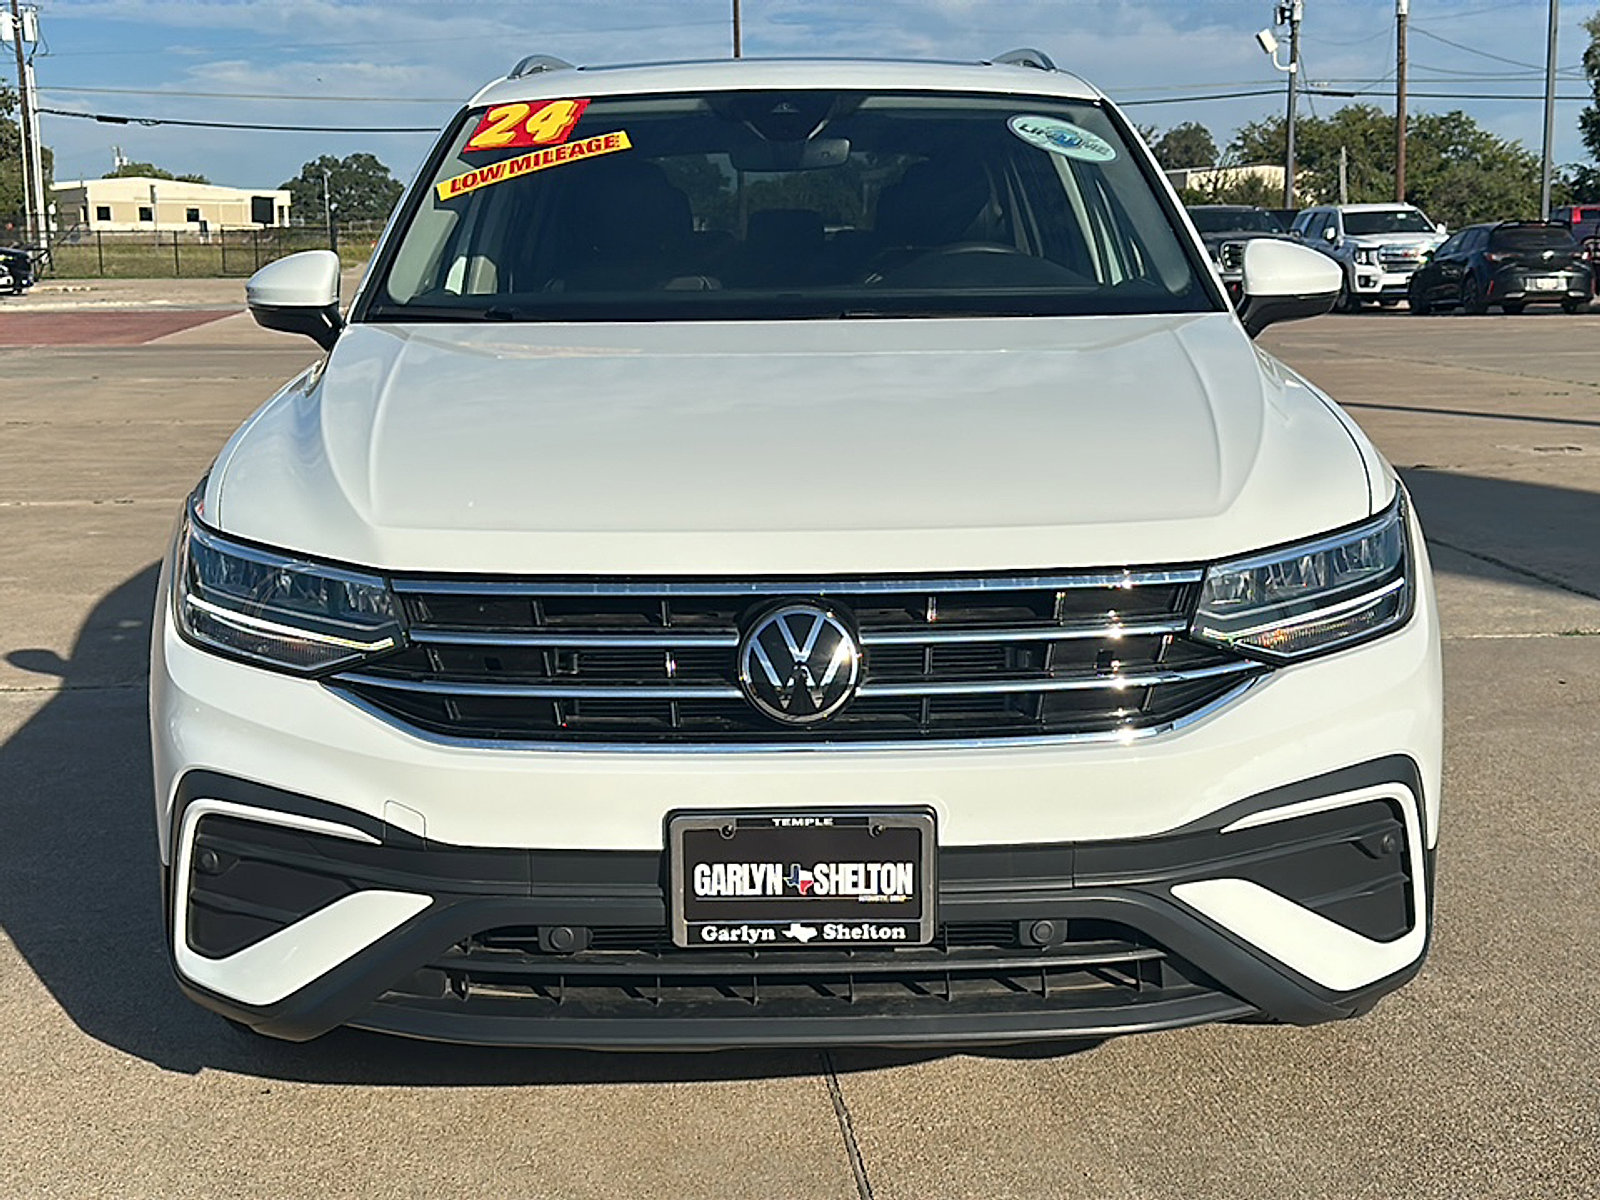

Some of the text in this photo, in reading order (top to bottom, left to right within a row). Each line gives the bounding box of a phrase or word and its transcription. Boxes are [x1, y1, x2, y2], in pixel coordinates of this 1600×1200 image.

[469, 101, 578, 148] 24
[450, 134, 621, 194] LOW MILEAGE
[771, 817, 835, 827] TEMPLE
[693, 862, 914, 896] GARLYN SHELTON
[701, 923, 907, 943] Garlyn Shelton
